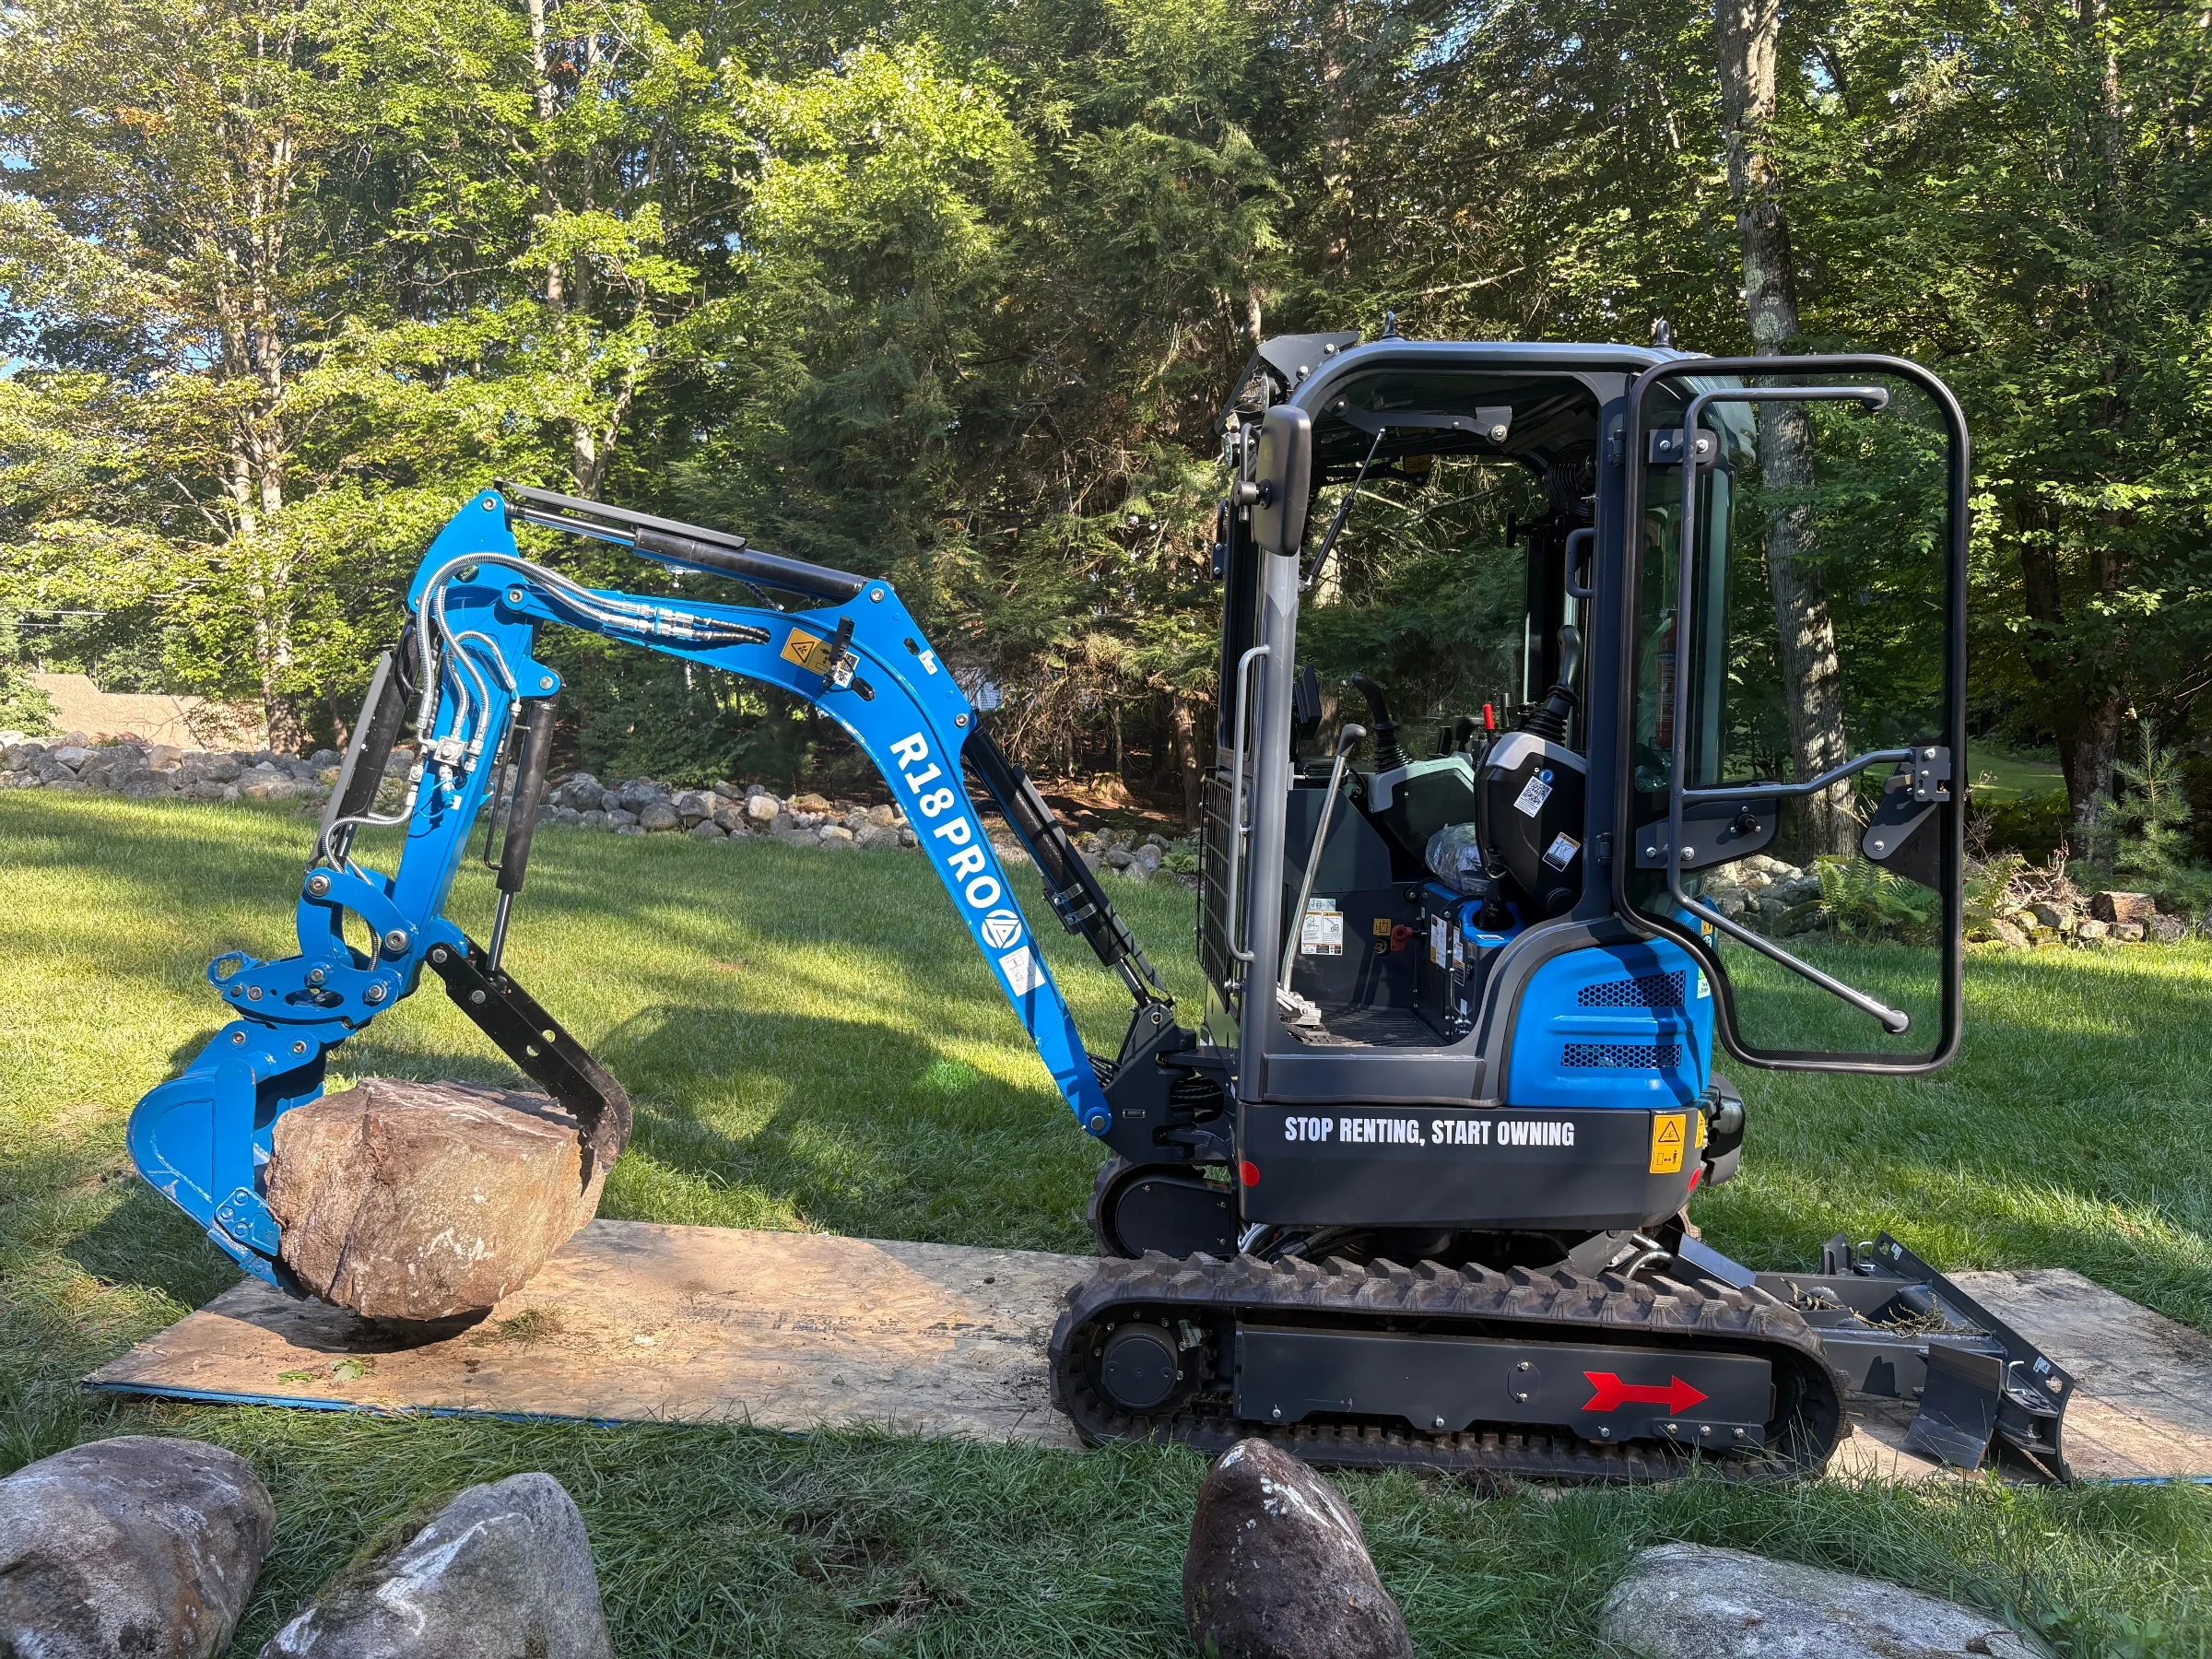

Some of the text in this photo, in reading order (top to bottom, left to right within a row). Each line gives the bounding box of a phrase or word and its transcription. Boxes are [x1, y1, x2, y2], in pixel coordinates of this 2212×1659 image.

[889, 732, 1001, 909] R18 PRO
[1285, 1116, 1574, 1147] STOP RENTING, START OWNING
